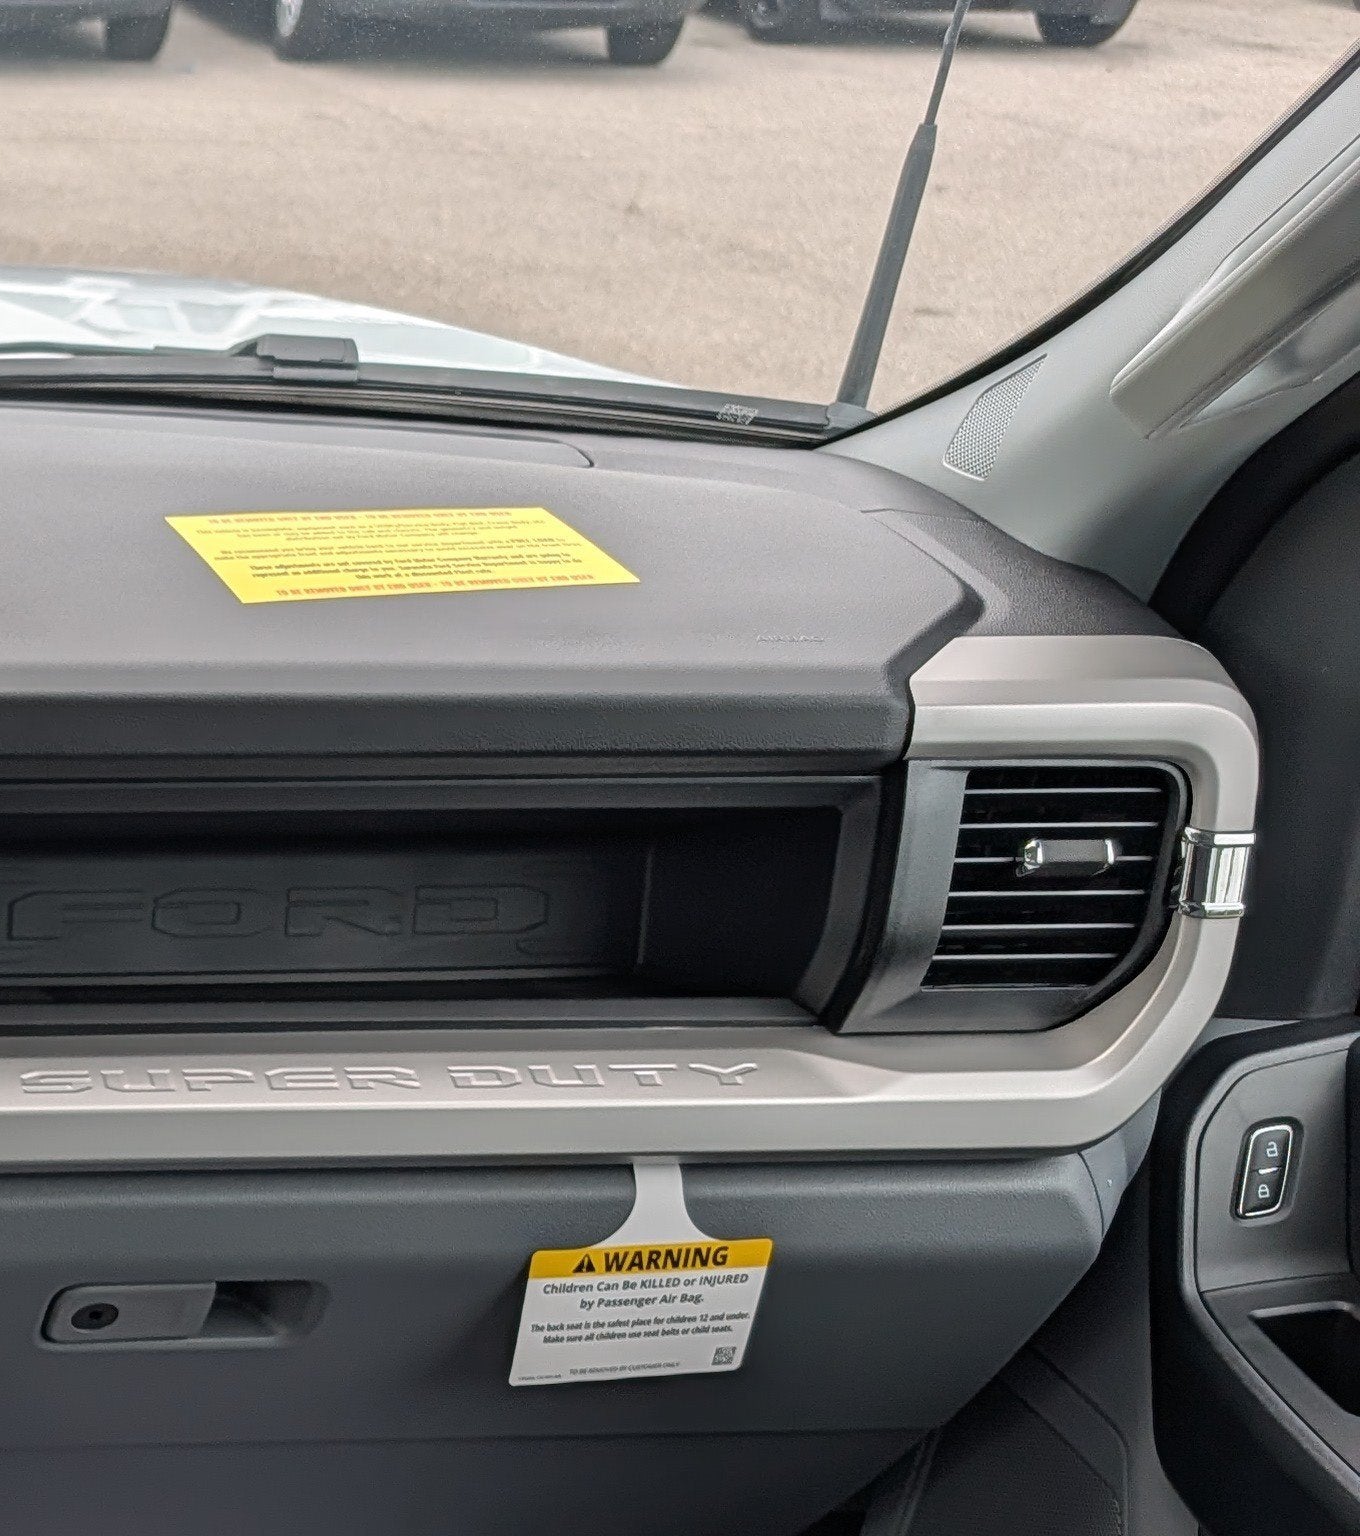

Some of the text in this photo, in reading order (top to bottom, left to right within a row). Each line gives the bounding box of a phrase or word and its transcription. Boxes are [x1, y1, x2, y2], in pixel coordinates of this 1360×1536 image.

[7, 884, 550, 941] FORD
[19, 1061, 759, 1093] SUPER DUTY
[603, 1245, 730, 1273] WARNING
[542, 1273, 749, 1295] Children Can Be KILLED or INJURED
[579, 1292, 705, 1310] by Passenger Air Bag.
[531, 1323, 545, 1333] The
[546, 1322, 565, 1332] back
[566, 1321, 583, 1330] seat
[593, 1319, 606, 1328] the
[607, 1318, 630, 1328] safest
[631, 1317, 651, 1328] place
[653, 1316, 665, 1325] for
[666, 1314, 698, 1325] children
[710, 1312, 725, 1322] and
[726, 1311, 751, 1321] under.
[543, 1334, 564, 1344] Make
[566, 1334, 583, 1342] sure
[585, 1332, 595, 1341] all
[595, 1331, 627, 1341] children
[628, 1331, 642, 1339] use
[643, 1329, 659, 1338] seat
[660, 1328, 680, 1338] belts
[692, 1326, 711, 1335] child
[712, 1324, 733, 1334] seats.
